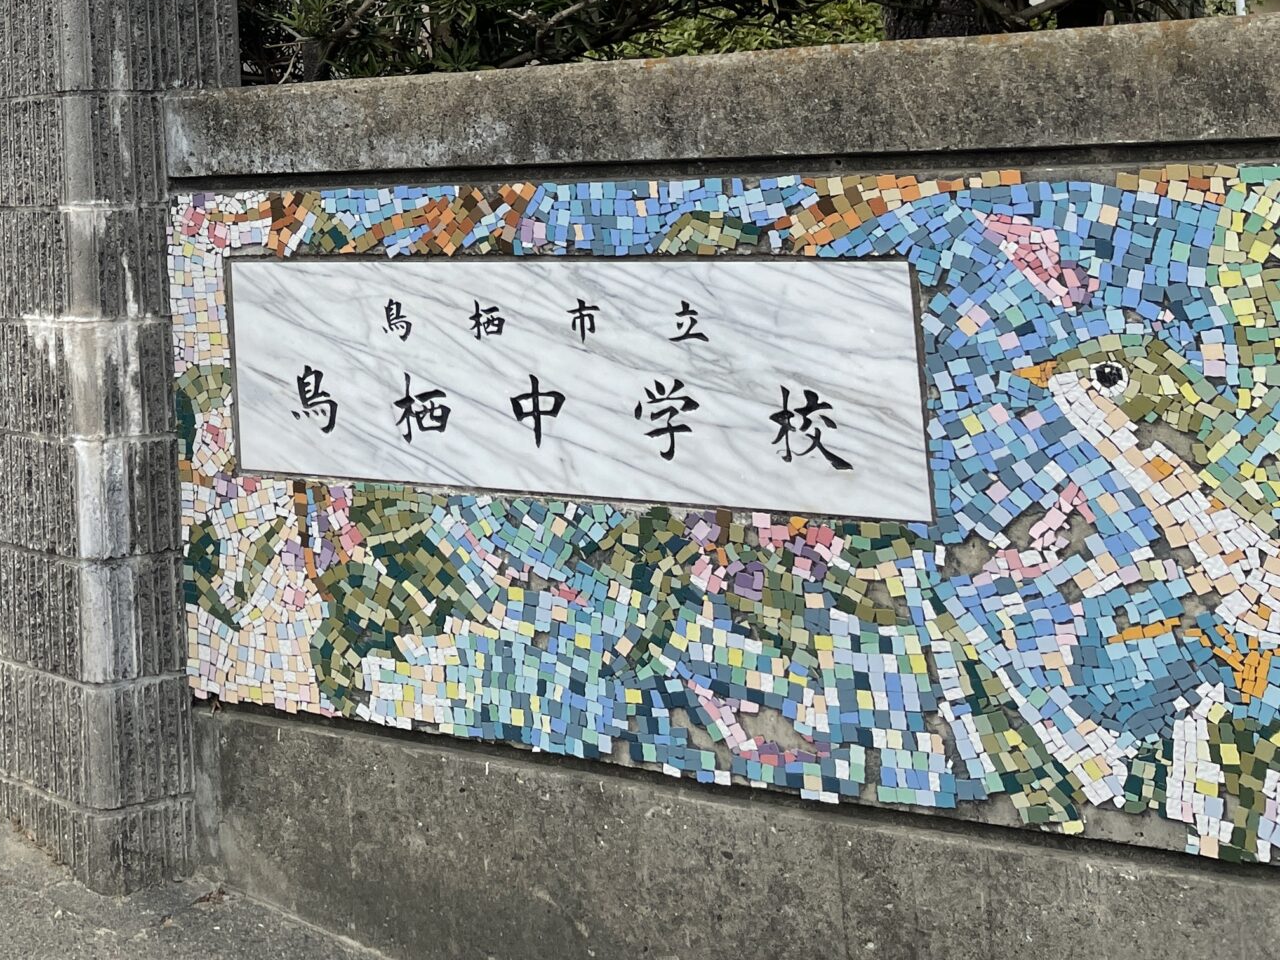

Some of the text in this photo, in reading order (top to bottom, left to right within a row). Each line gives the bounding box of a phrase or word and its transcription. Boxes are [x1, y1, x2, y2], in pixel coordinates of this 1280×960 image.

[382, 298, 710, 343] 鳥栖市立
[291, 364, 854, 471] 鳥栖中学校
